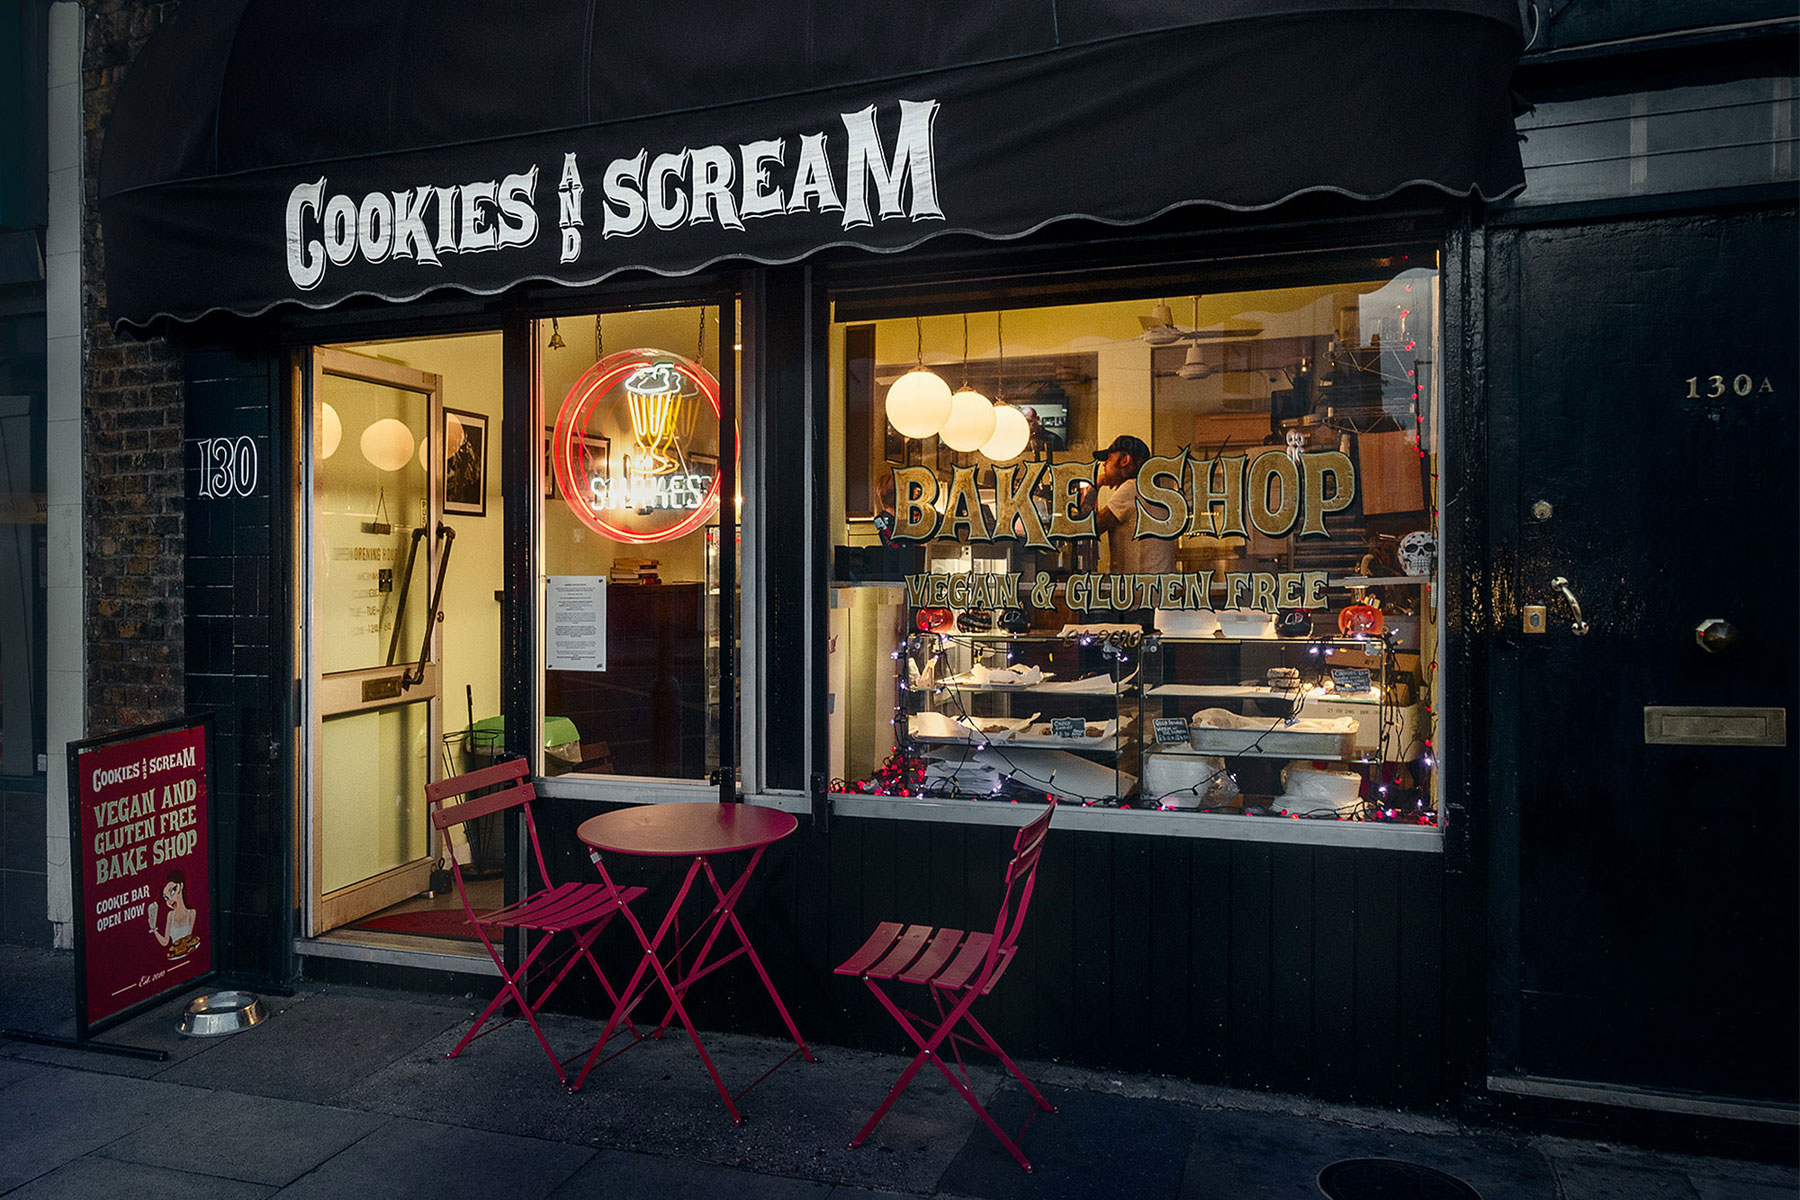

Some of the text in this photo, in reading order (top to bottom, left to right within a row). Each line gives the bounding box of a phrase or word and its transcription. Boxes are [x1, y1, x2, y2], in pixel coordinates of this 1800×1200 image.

[285, 98, 947, 291] COOKIES AND SCREAM
[198, 436, 257, 499] 130
[890, 448, 1358, 553] BAKE SHOP
[903, 571, 1331, 616] VEGAN & GLUTEN FREE
[92, 762, 140, 792] COOKIES
[149, 746, 196, 774] SCREAM
[93, 778, 197, 829] VEGAN AND
[94, 805, 197, 855] GLUTEN FREE
[95, 829, 198, 885] BAKE SHOP
[96, 884, 151, 915] COOKIE BAR
[96, 902, 146, 932] OPEN NOW
